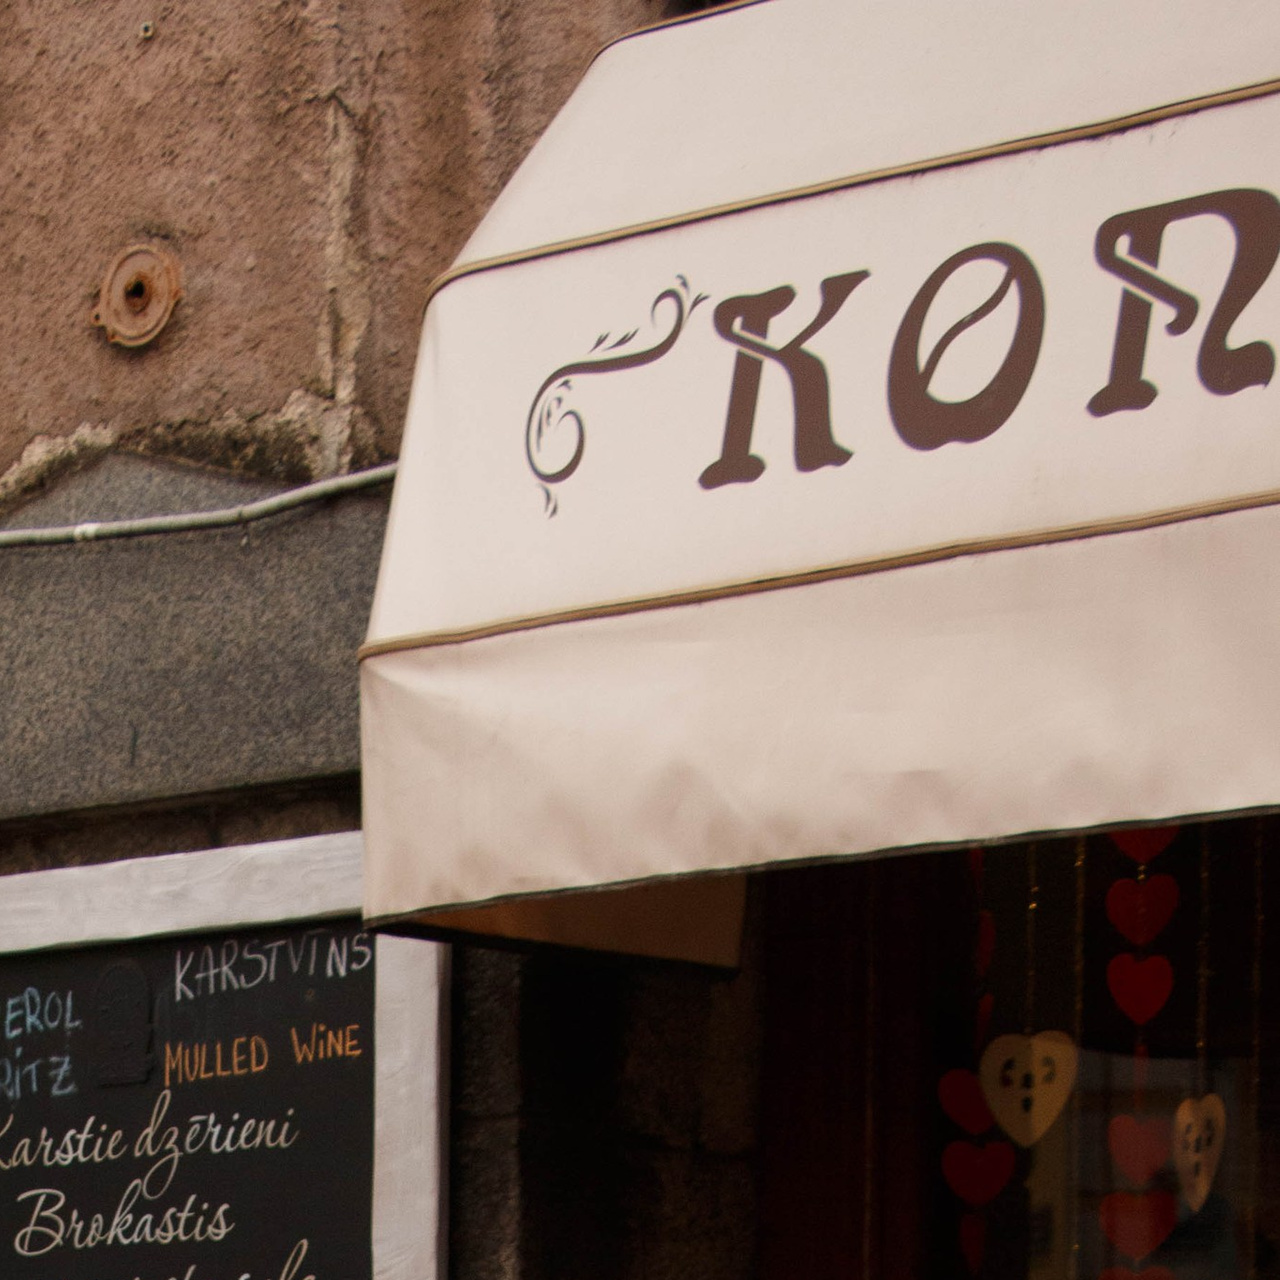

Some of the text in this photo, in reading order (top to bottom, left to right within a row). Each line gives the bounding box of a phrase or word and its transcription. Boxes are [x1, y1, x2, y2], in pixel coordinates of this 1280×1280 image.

[163, 1035, 269, 1087] MULLED
[134, 1089, 298, 1199] dzērieni
[15, 1178, 235, 1256] Brokastis
